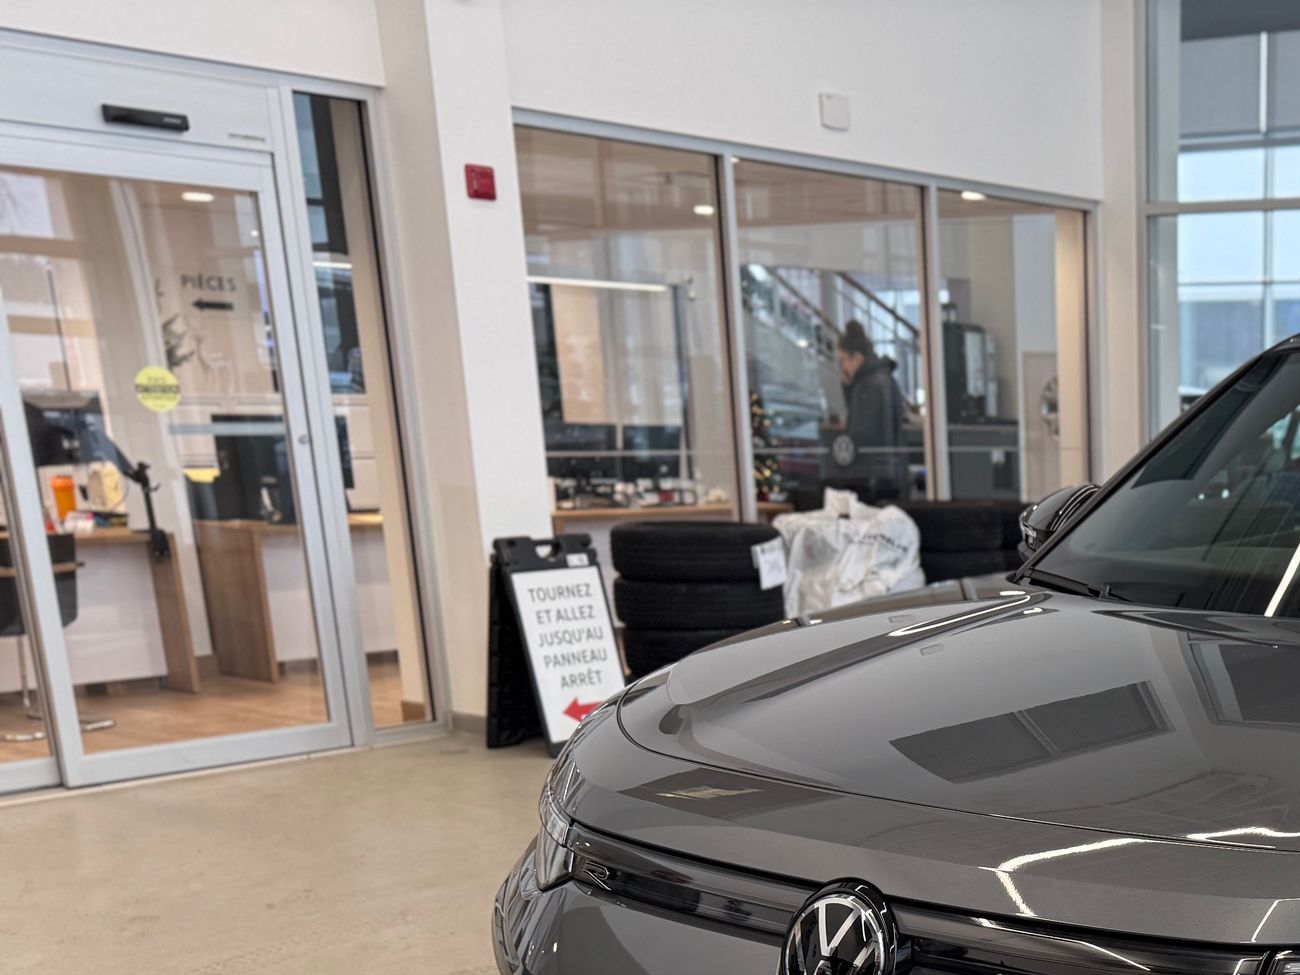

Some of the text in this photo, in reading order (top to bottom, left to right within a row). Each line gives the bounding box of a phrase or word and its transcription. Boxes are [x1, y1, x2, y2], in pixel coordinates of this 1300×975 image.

[527, 583, 592, 602] TOURNEZ
[535, 605, 596, 624] ET ALLEZ
[538, 626, 604, 648] JUSQU'AU
[543, 648, 608, 669] PANNEAU
[561, 667, 603, 690] ARRÊT
